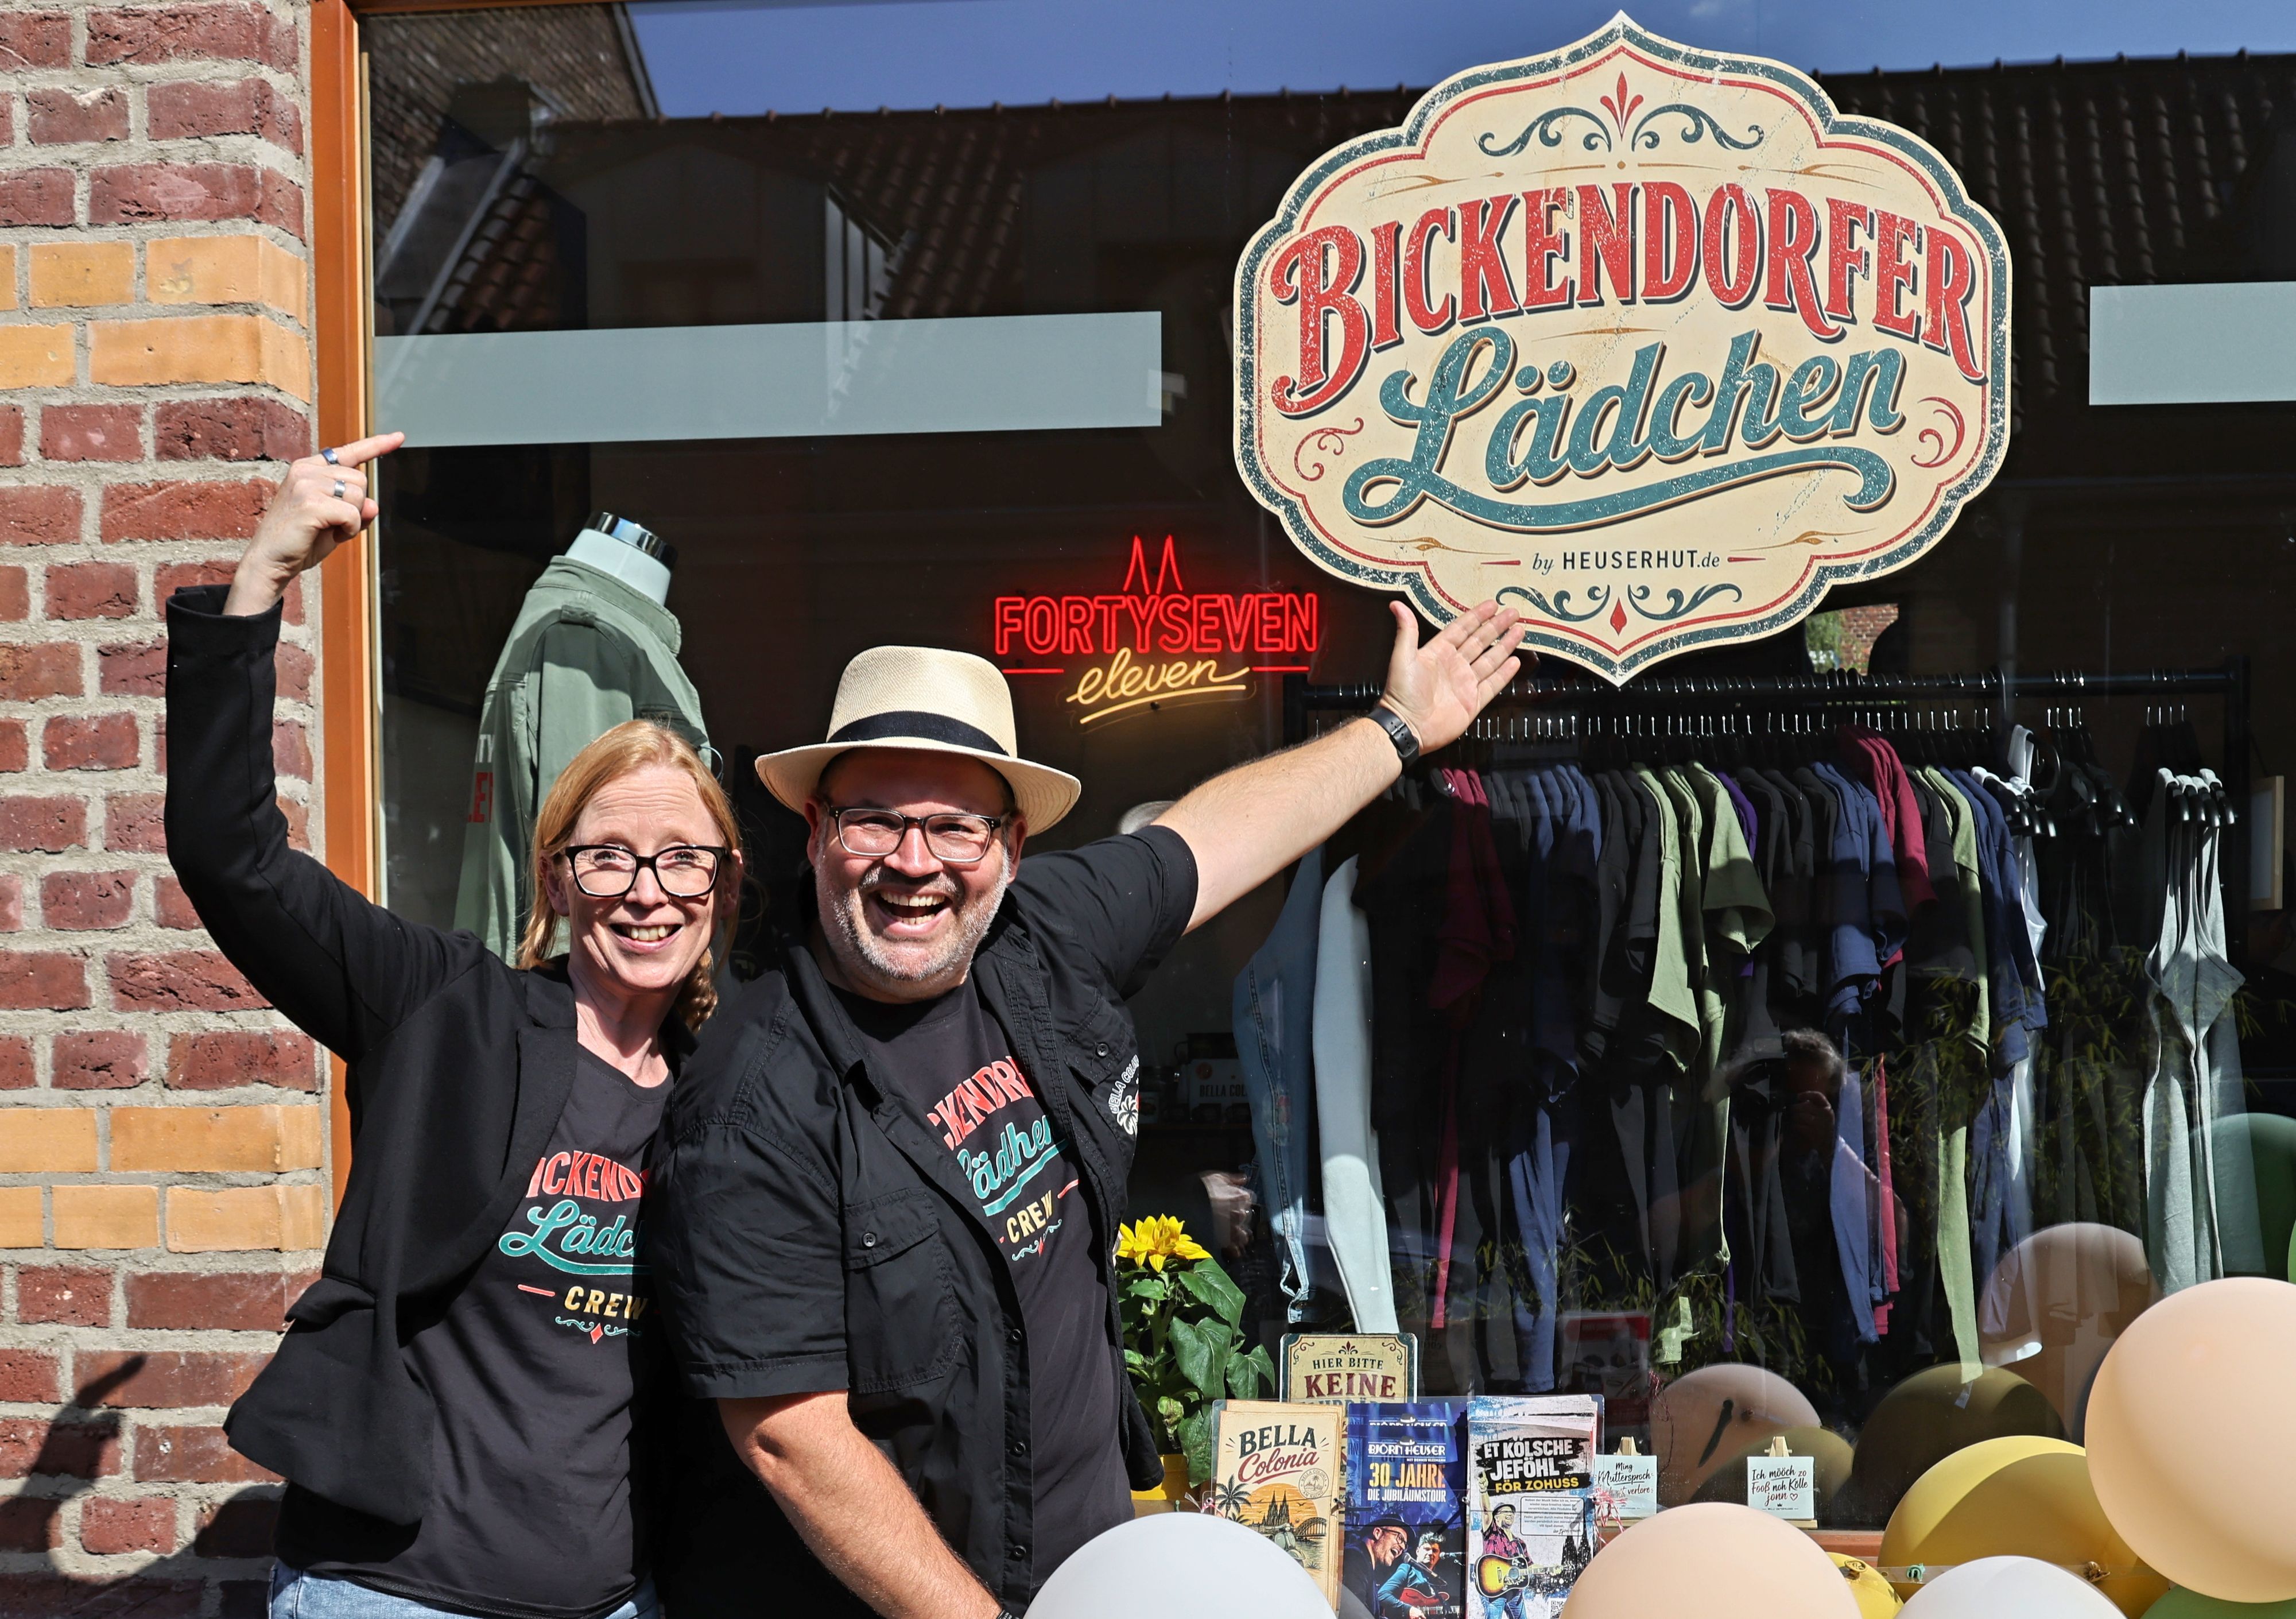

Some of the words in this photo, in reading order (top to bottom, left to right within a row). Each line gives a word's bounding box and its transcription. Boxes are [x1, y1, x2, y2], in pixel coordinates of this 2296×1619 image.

[1270, 181, 1988, 419] BICKENDORFER
[1341, 326, 1907, 532] Lädchen
[1532, 552, 1554, 574] by
[1562, 549, 1721, 571] HEUSERHUT.de
[994, 592, 1318, 655] FORTYSEVEN
[1066, 647, 1250, 705] eleven
[1108, 1080, 1126, 1114] BELLA
[1200, 1085, 1226, 1097] BELLA
[1230, 1084, 1248, 1097] COL
[1006, 1190, 1052, 1244] CREW
[498, 1199, 645, 1276] Lädc
[564, 1285, 649, 1320] CREW
[1312, 1358, 1343, 1369] HIER
[1349, 1358, 1383, 1370] BITTE
[1304, 1373, 1397, 1399] KEINE
[1239, 1424, 1317, 1459] BELLA
[1368, 1443, 1403, 1455] BJÖRN
[1405, 1444, 1445, 1455] HEUSER
[1484, 1442, 1500, 1459] ET
[1502, 1436, 1573, 1459] KÖLSCHE
[1238, 1447, 1320, 1484] Colonia
[1369, 1462, 1391, 1488] 30
[1395, 1463, 1446, 1488] JAHRE
[1490, 1457, 1560, 1481] JEFÖHL
[1597, 1469, 1651, 1486] Muttersproch
[1615, 1462, 1633, 1473] Ming
[1752, 1469, 1766, 1481] Ich
[1769, 1465, 1796, 1478] mööch
[1367, 1488, 1380, 1501] DIE
[1382, 1488, 1446, 1502] JUBILÄUMSTOUR
[1495, 1479, 1522, 1493] FÖR
[1525, 1477, 1579, 1491] ZOHUSS
[1627, 1484, 1650, 1495] verlore
[1789, 1478, 1809, 1491] Kölle
[1764, 1492, 1788, 1507] jonn
